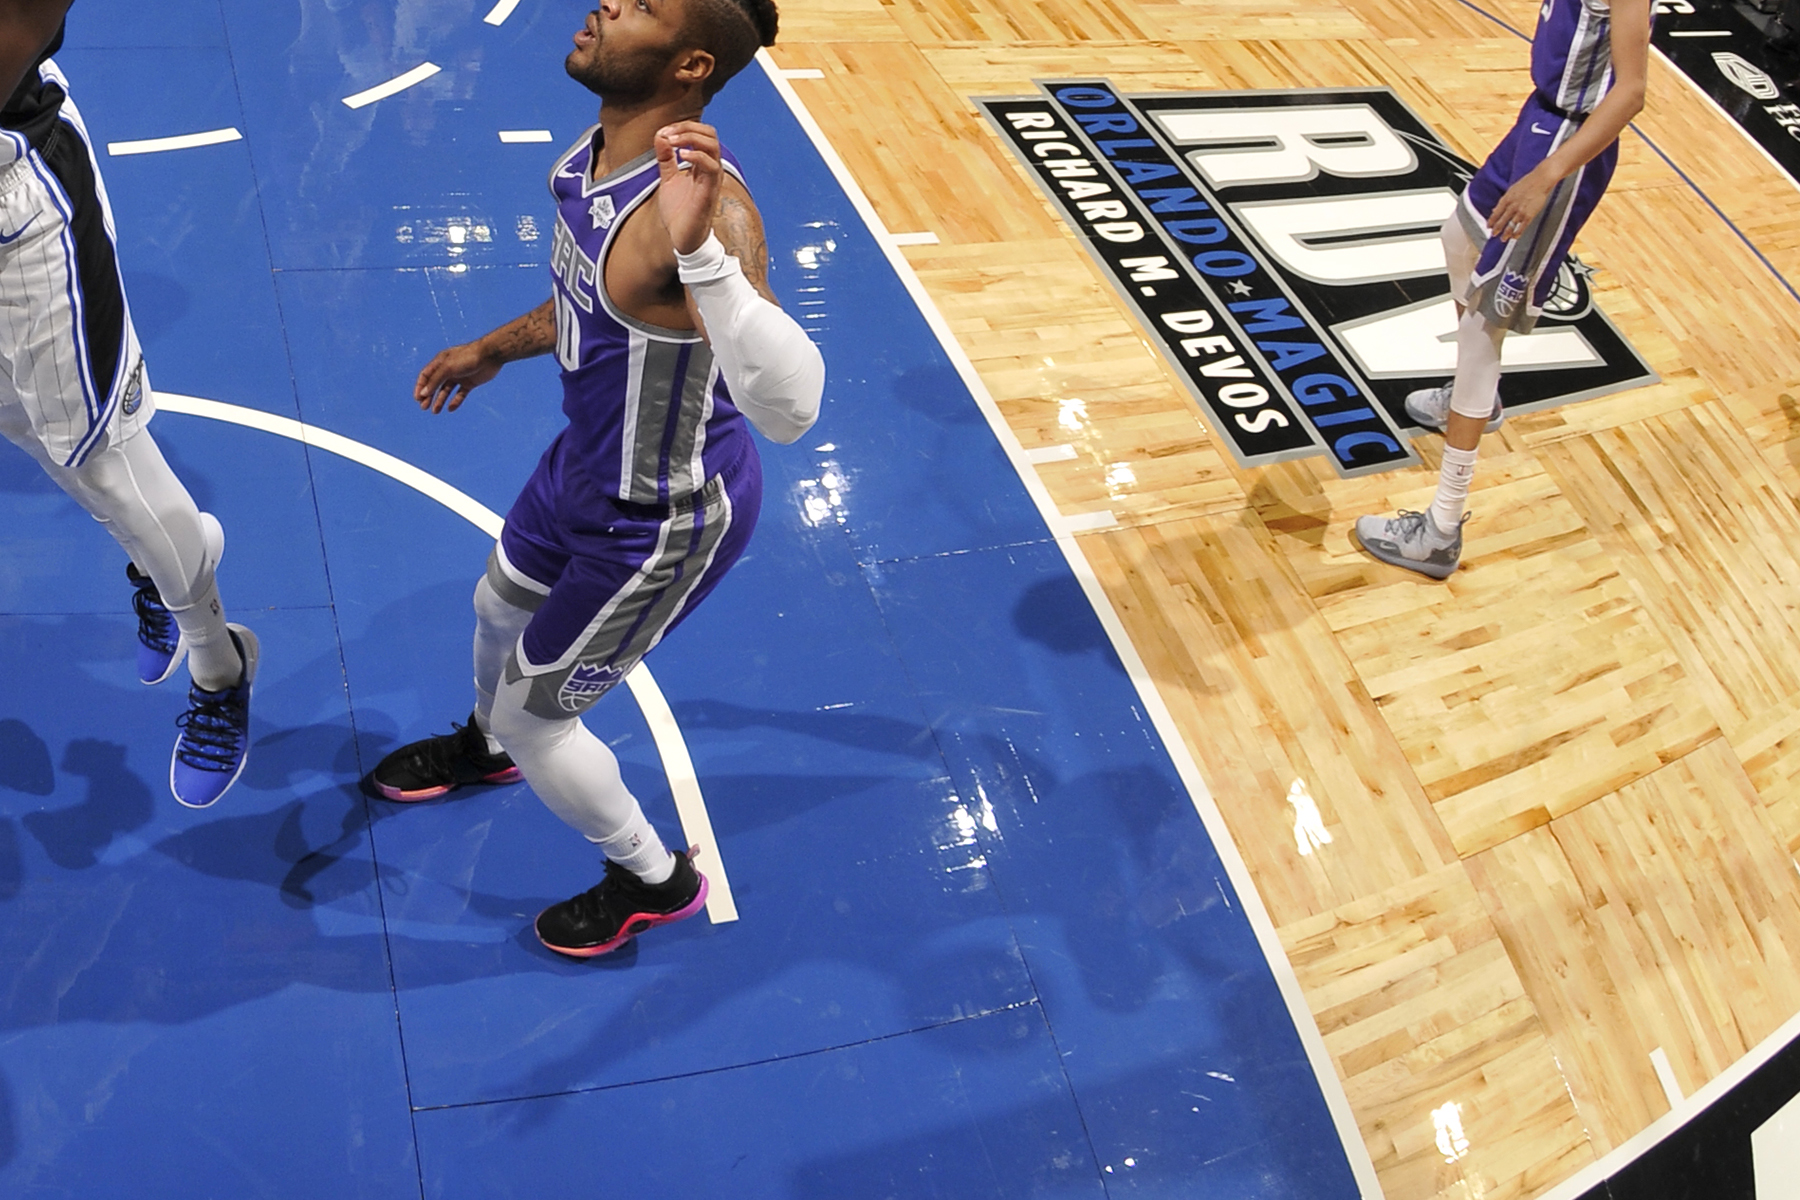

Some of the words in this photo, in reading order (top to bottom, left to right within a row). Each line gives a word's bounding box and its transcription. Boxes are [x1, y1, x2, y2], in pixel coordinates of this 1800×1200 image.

[1005, 112, 1145, 244] RICHARD
[1119, 256, 1179, 297] M.
[1161, 310, 1289, 434] DEVOS
[1054, 86, 1241, 278] ORLANDO
[1229, 297, 1399, 462] MAGIC
[1153, 104, 1608, 380] RDV
